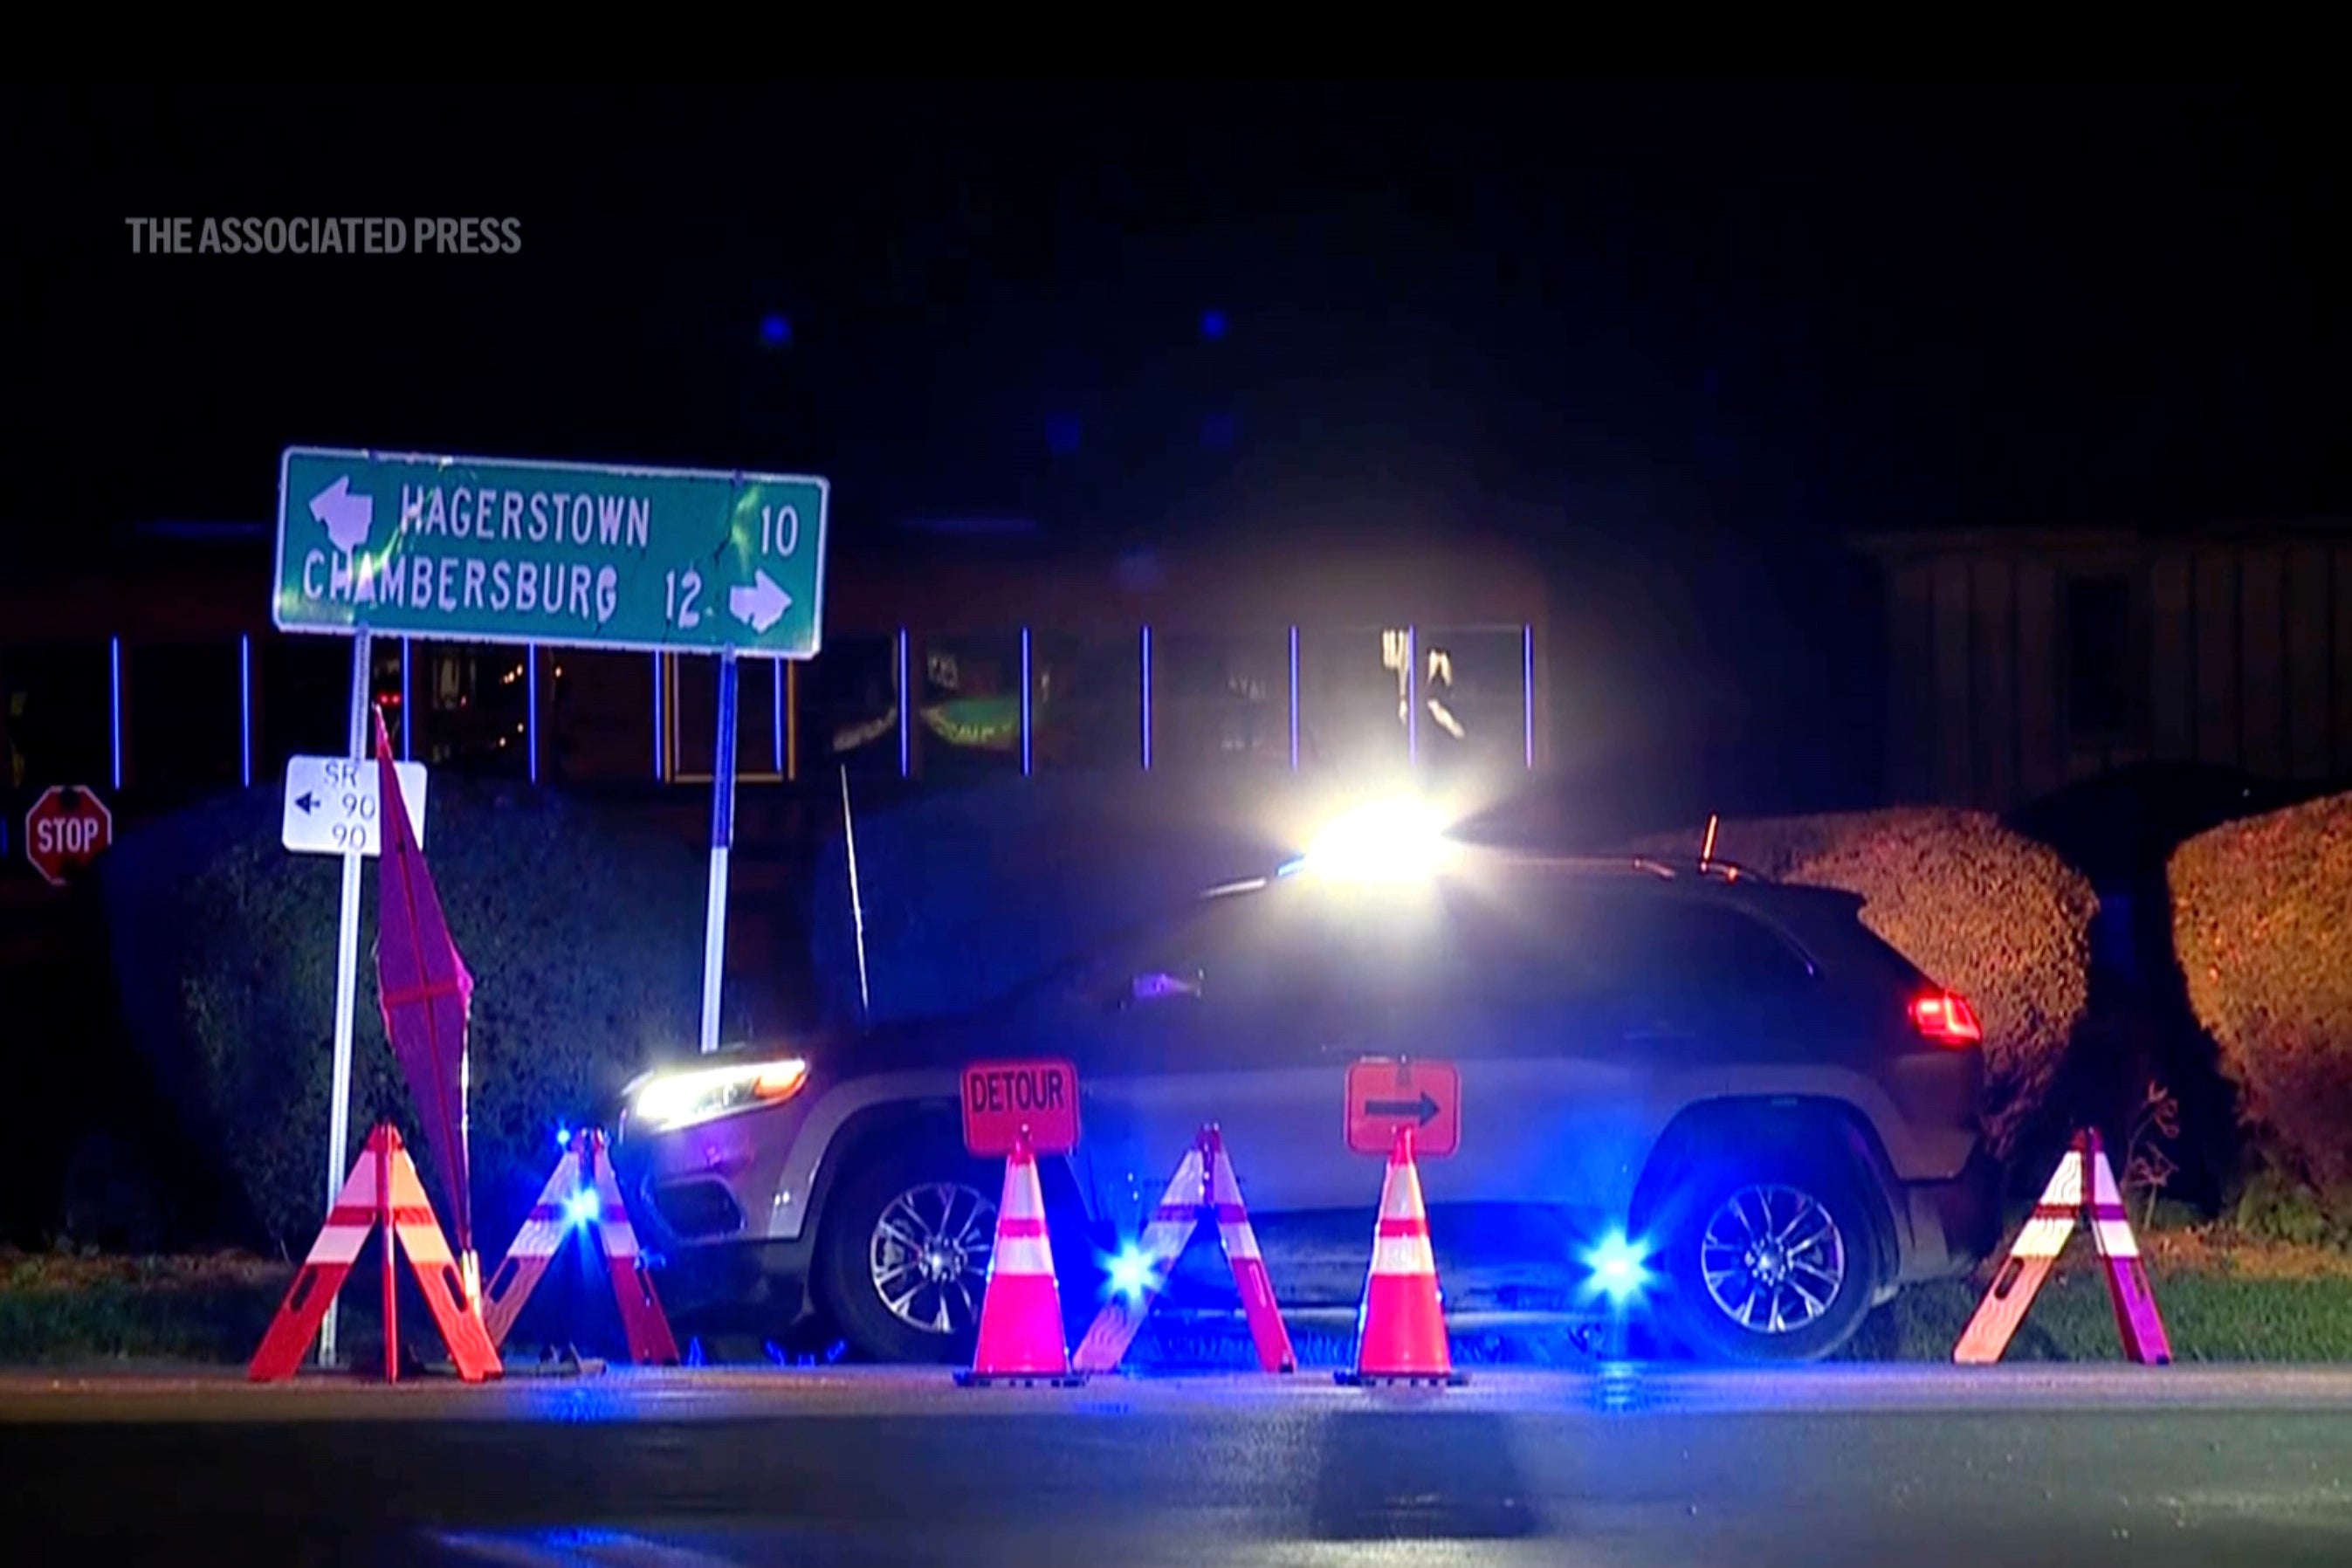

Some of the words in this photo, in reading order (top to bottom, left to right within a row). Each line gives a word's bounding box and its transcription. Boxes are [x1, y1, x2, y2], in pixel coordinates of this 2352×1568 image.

[402, 484, 650, 548] HAGERSTOWN
[760, 505, 800, 557] 10
[302, 549, 618, 622] CHAMBERSBURG
[665, 567, 703, 629] 12
[325, 760, 359, 787] SR
[342, 793, 376, 822] 90
[38, 817, 99, 854] STOP
[332, 822, 366, 850] 90
[970, 1069, 1064, 1112] DETOUR
